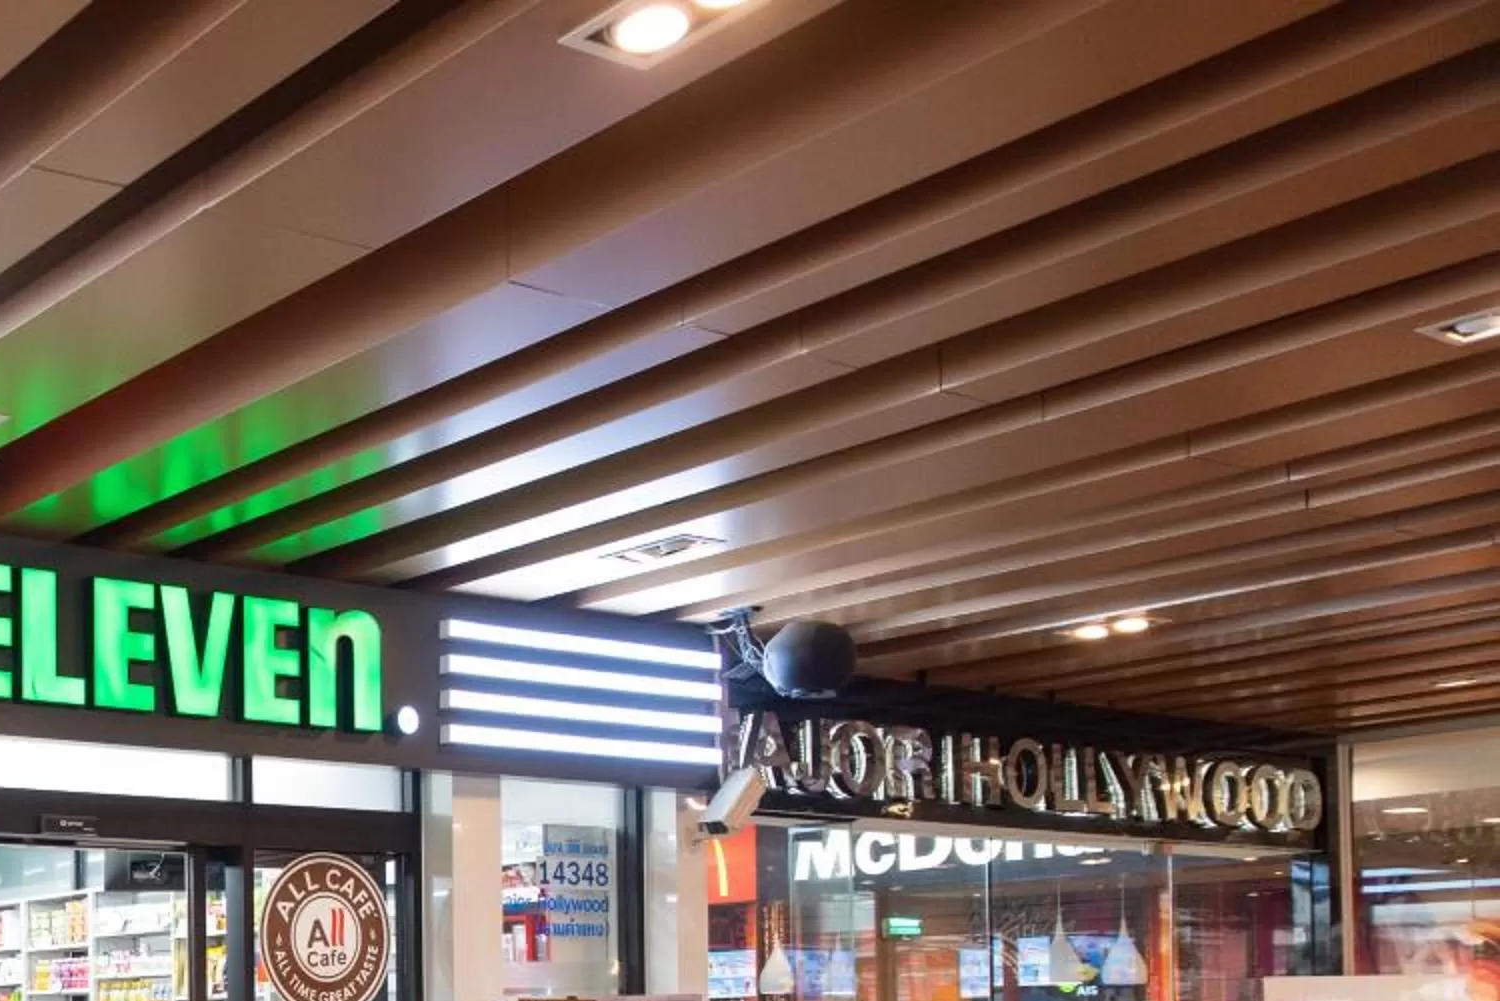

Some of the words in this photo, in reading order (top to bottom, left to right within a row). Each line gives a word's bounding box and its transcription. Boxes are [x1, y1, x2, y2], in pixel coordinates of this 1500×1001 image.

[722, 708, 935, 800] AJOR
[946, 728, 1323, 832] HOLLYWOOD
[540, 860, 609, 886] 14348
[276, 871, 320, 923] ALL
[537, 895, 609, 914] Hollywood
[308, 907, 345, 948] All
[274, 951, 291, 978] ALL
[356, 945, 379, 986] TASTE
